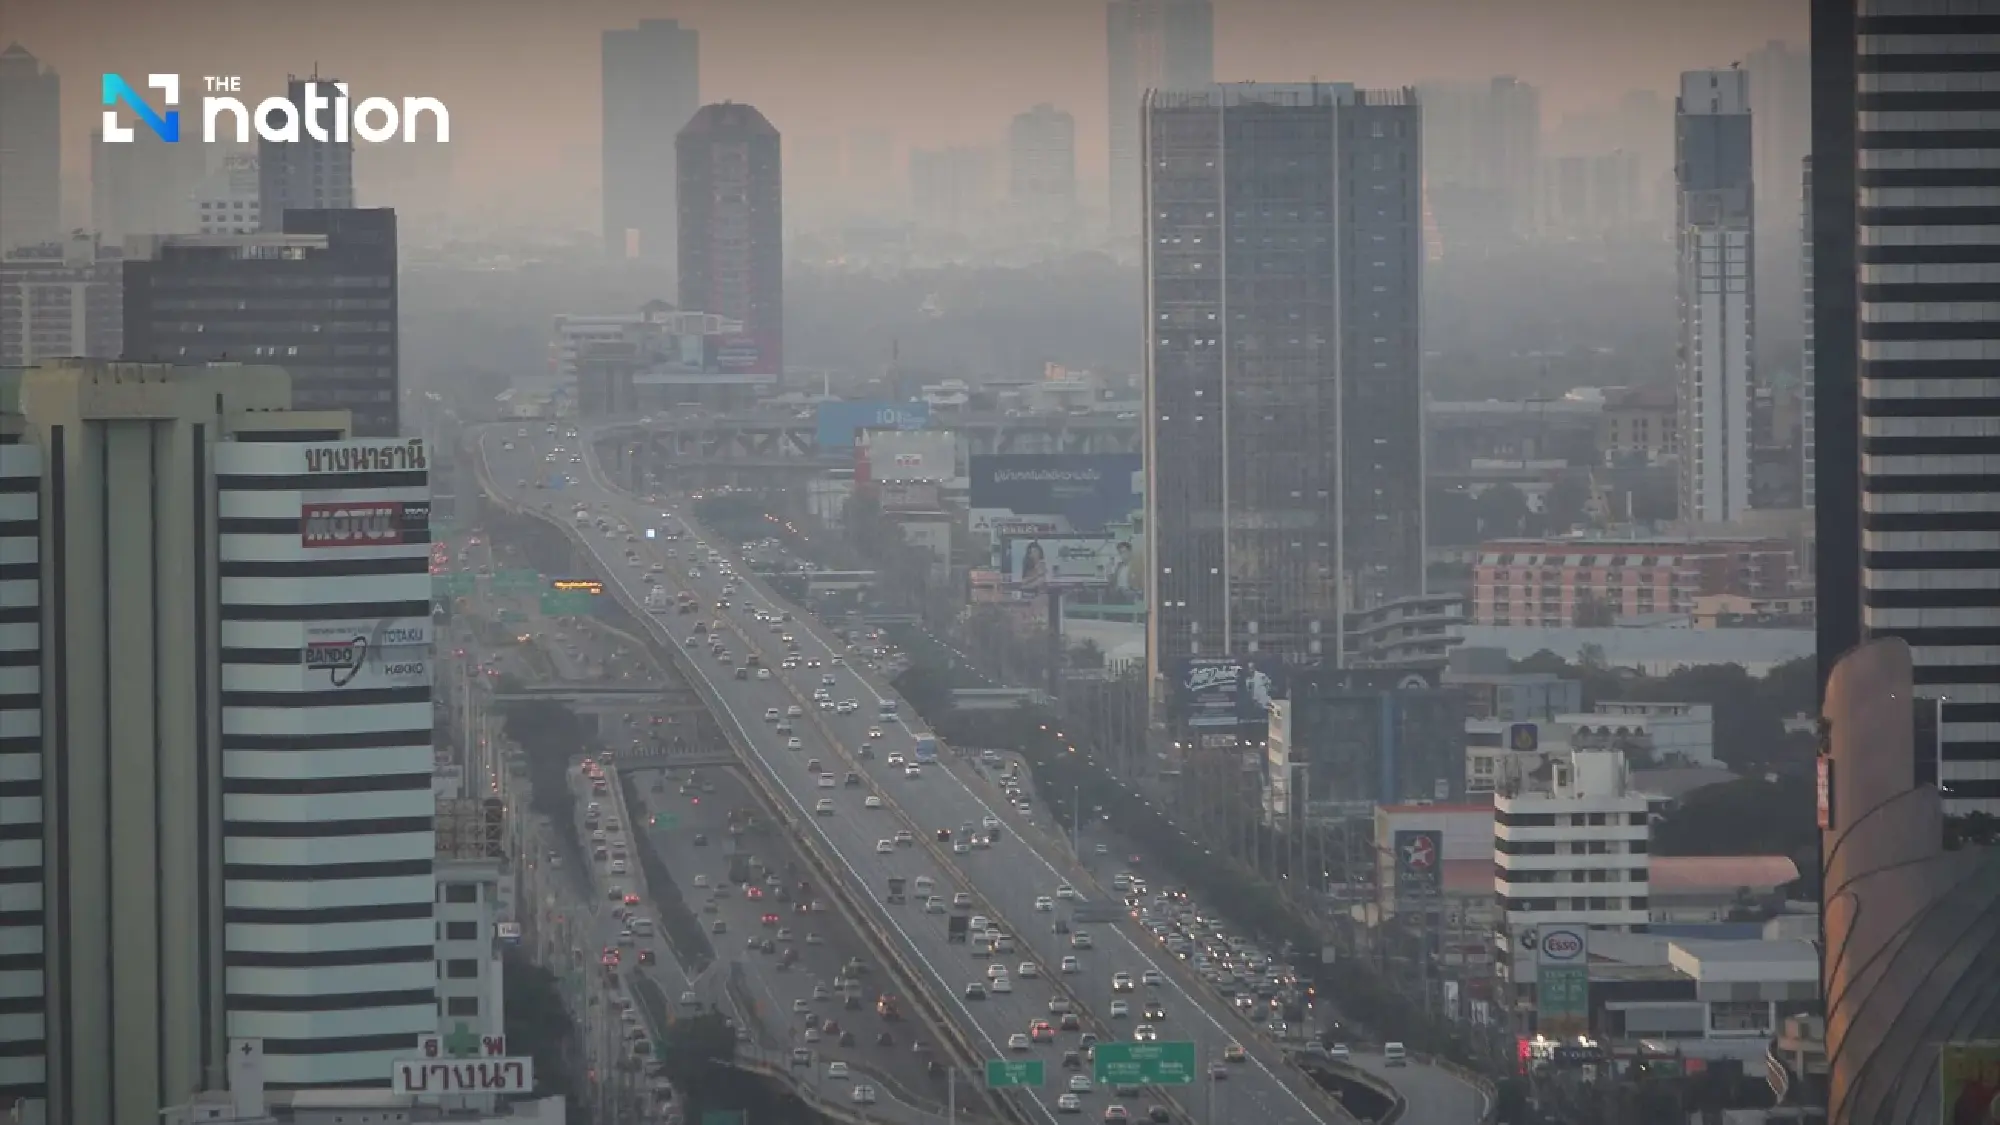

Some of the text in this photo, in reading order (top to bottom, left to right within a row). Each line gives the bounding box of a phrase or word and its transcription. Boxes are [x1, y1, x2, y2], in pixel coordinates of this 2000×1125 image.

[306, 439, 426, 472] บางนาธานี
[307, 508, 397, 540] MOTUL
[306, 647, 353, 663] BANDO
[1548, 938, 1578, 951] Esso
[402, 1062, 524, 1091] บางนา
